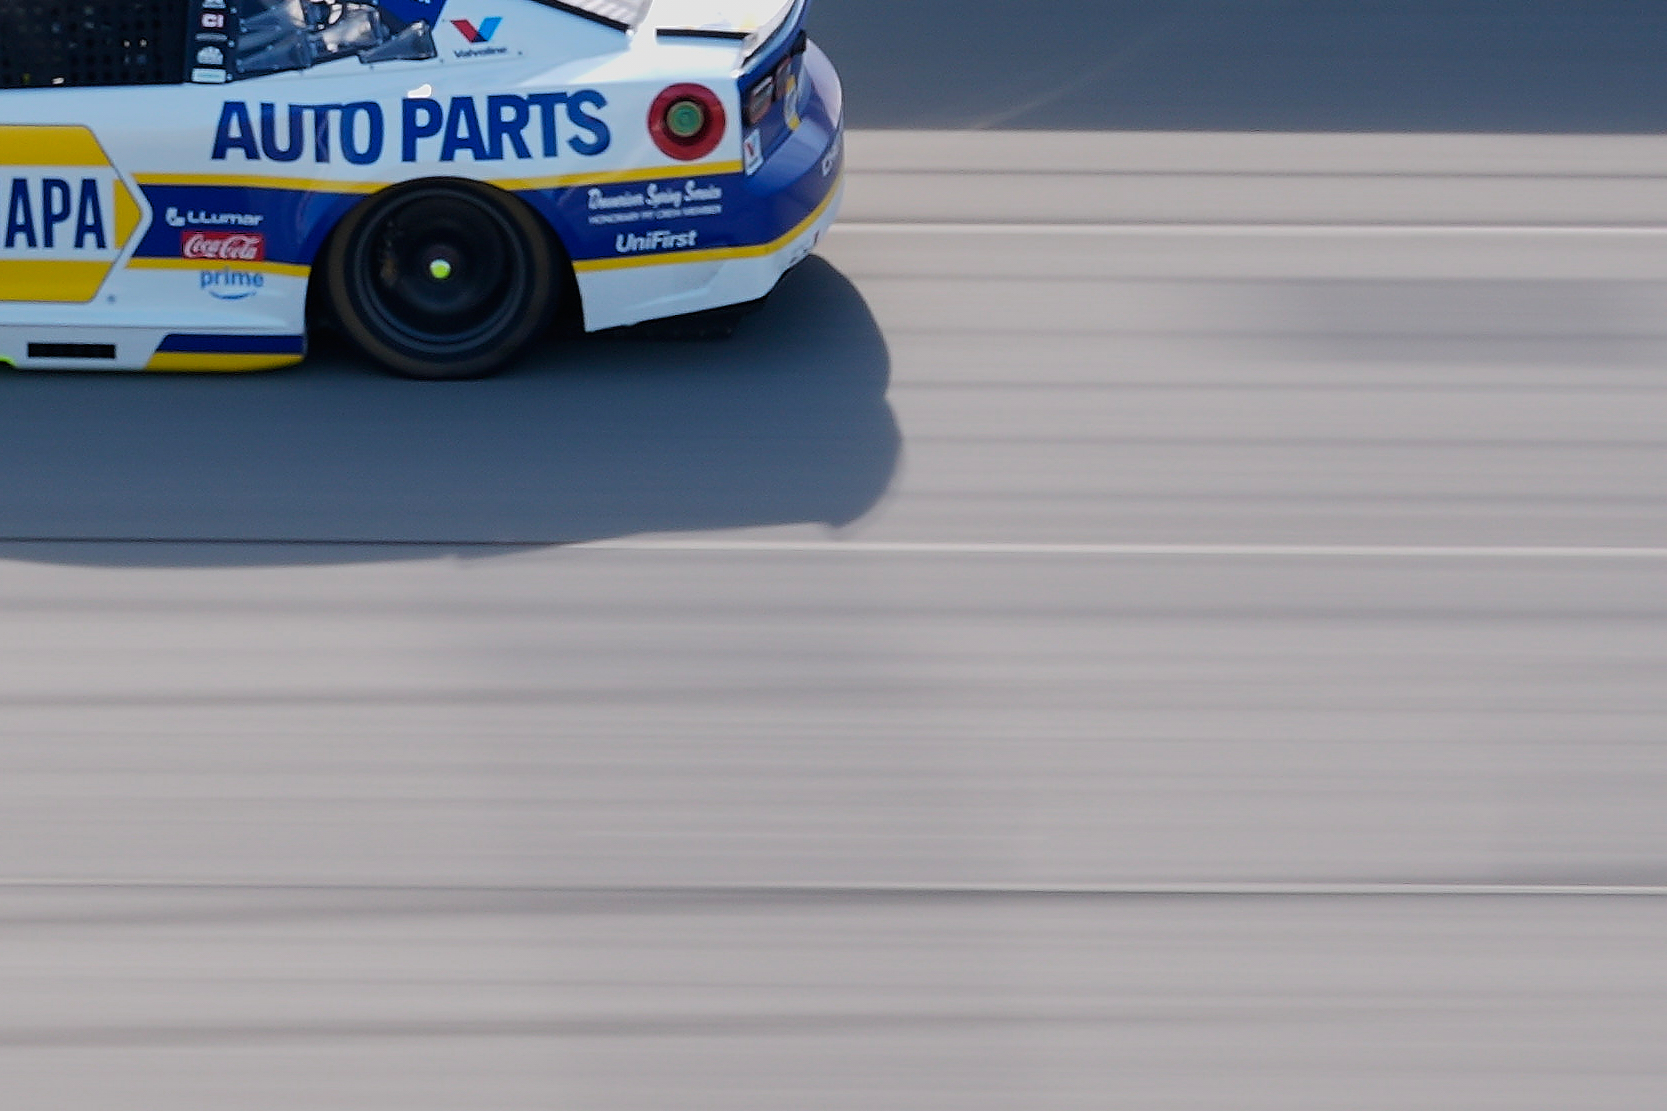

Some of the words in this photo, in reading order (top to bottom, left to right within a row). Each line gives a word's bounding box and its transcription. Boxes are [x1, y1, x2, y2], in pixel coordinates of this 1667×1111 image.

[211, 100, 383, 165] AUTO
[401, 90, 611, 162] PARTS
[616, 229, 698, 253] UniFirst
[200, 267, 263, 289] prime
